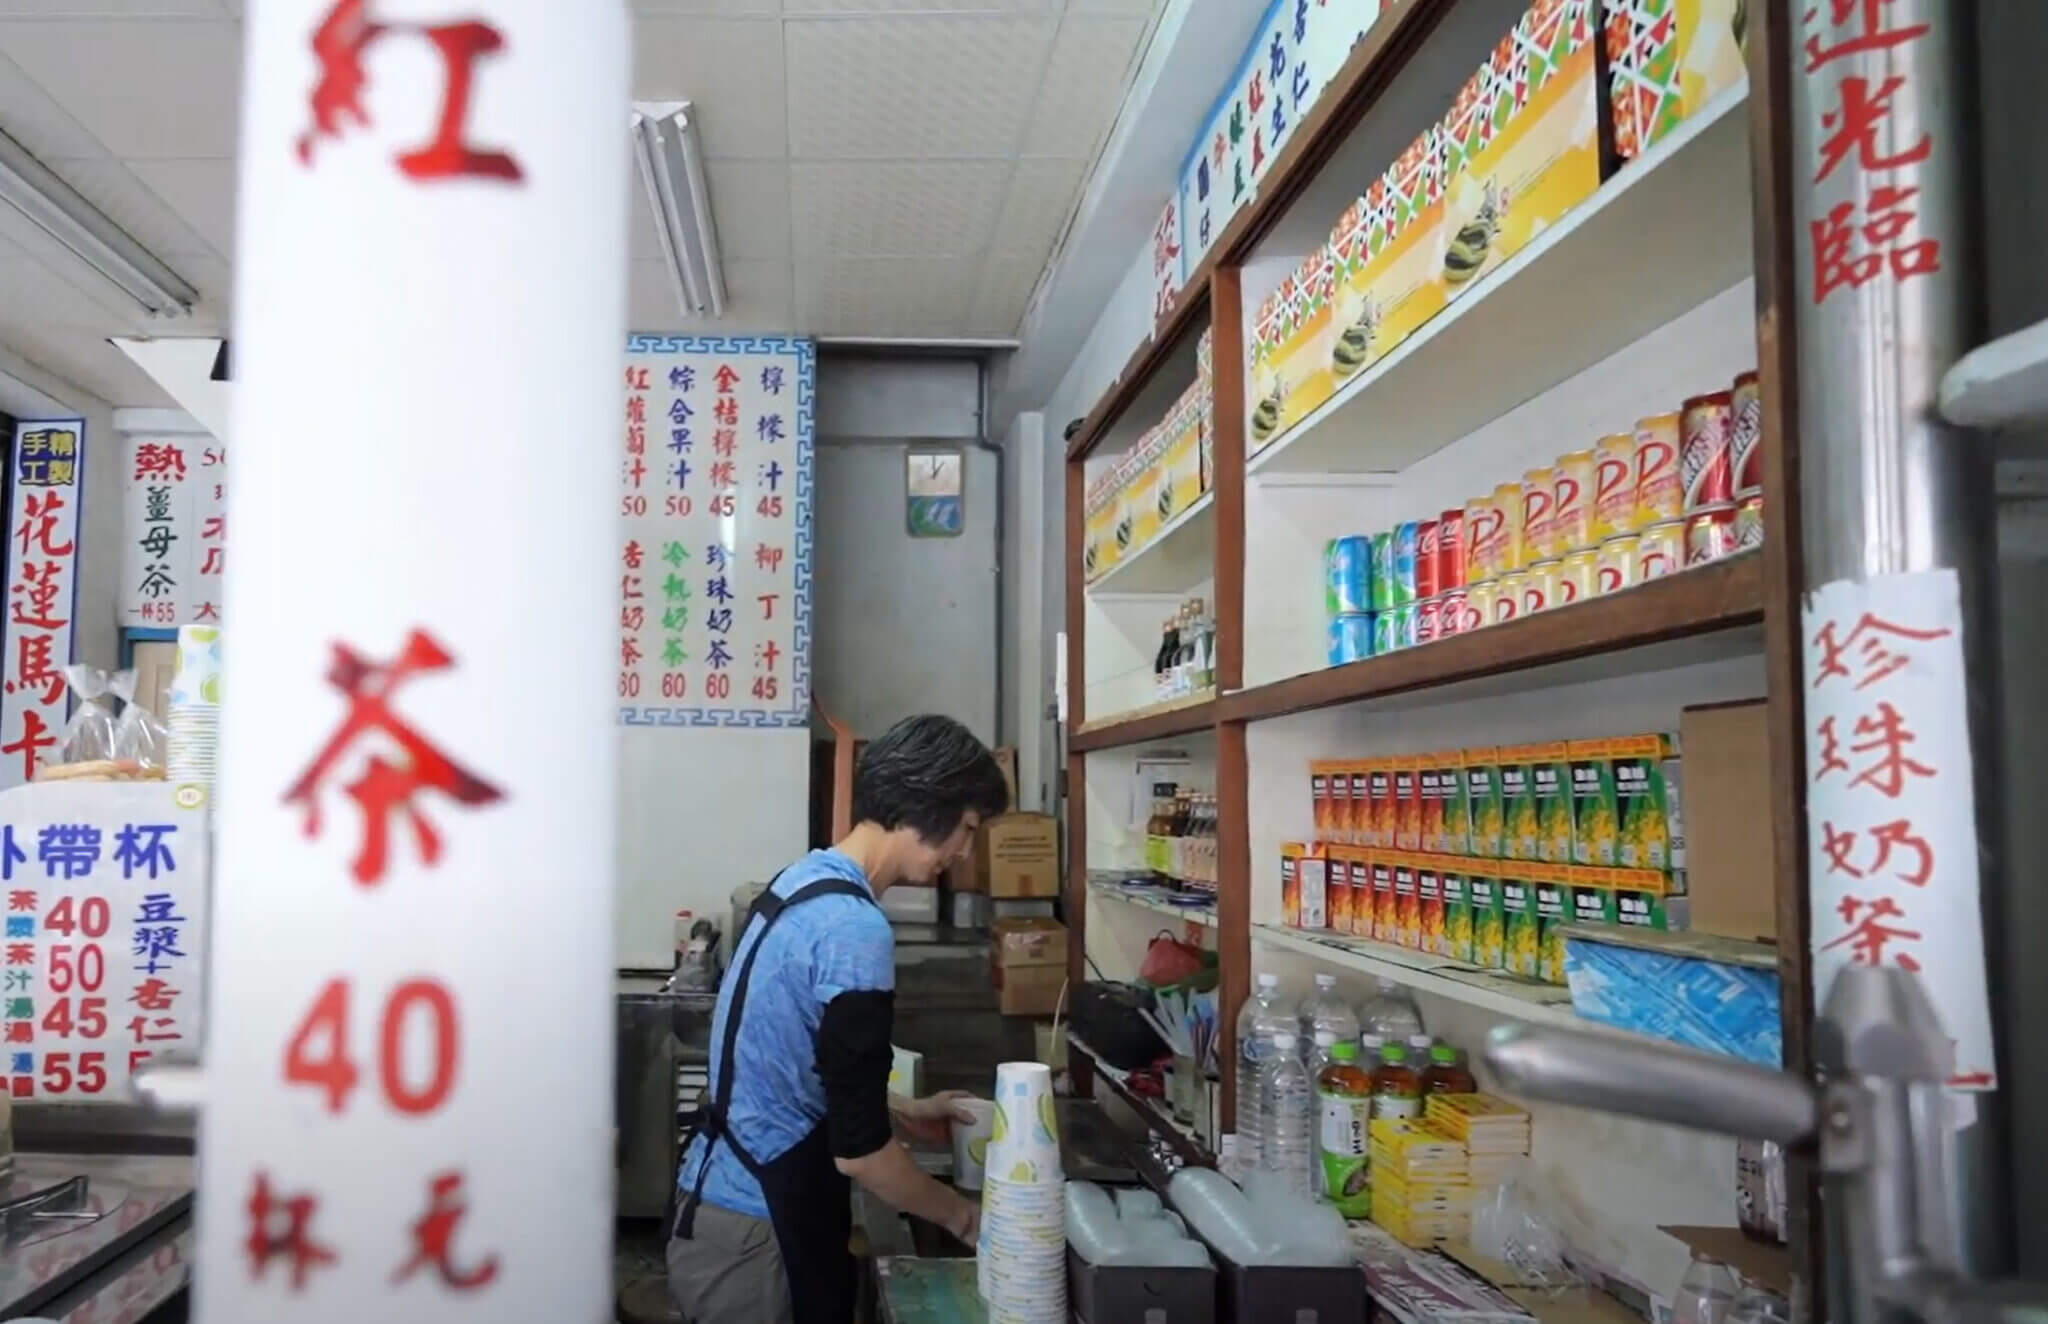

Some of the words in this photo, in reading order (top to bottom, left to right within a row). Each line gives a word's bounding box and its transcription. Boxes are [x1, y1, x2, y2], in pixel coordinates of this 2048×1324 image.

[666, 365, 695, 490] 綜合果汁
[134, 443, 187, 482] 熱
[621, 495, 647, 517] 50
[664, 495, 692, 516] 50
[709, 496, 735, 518] 45
[756, 496, 783, 518] 45
[138, 486, 178, 599] 薑母茶
[622, 539, 645, 666] 杏仁奶茶
[705, 543, 735, 670] 珍珠奶茶
[754, 543, 783, 671] 柳丁汁
[662, 672, 686, 698] 60
[706, 673, 730, 699] 60
[752, 677, 777, 700] 45
[1813, 612, 1952, 973] 珍珠奶茶
[44, 896, 110, 938] 40
[48, 944, 105, 993] 50
[42, 997, 108, 1039] 45
[281, 974, 459, 1118] 40
[42, 1052, 107, 1094] 55
